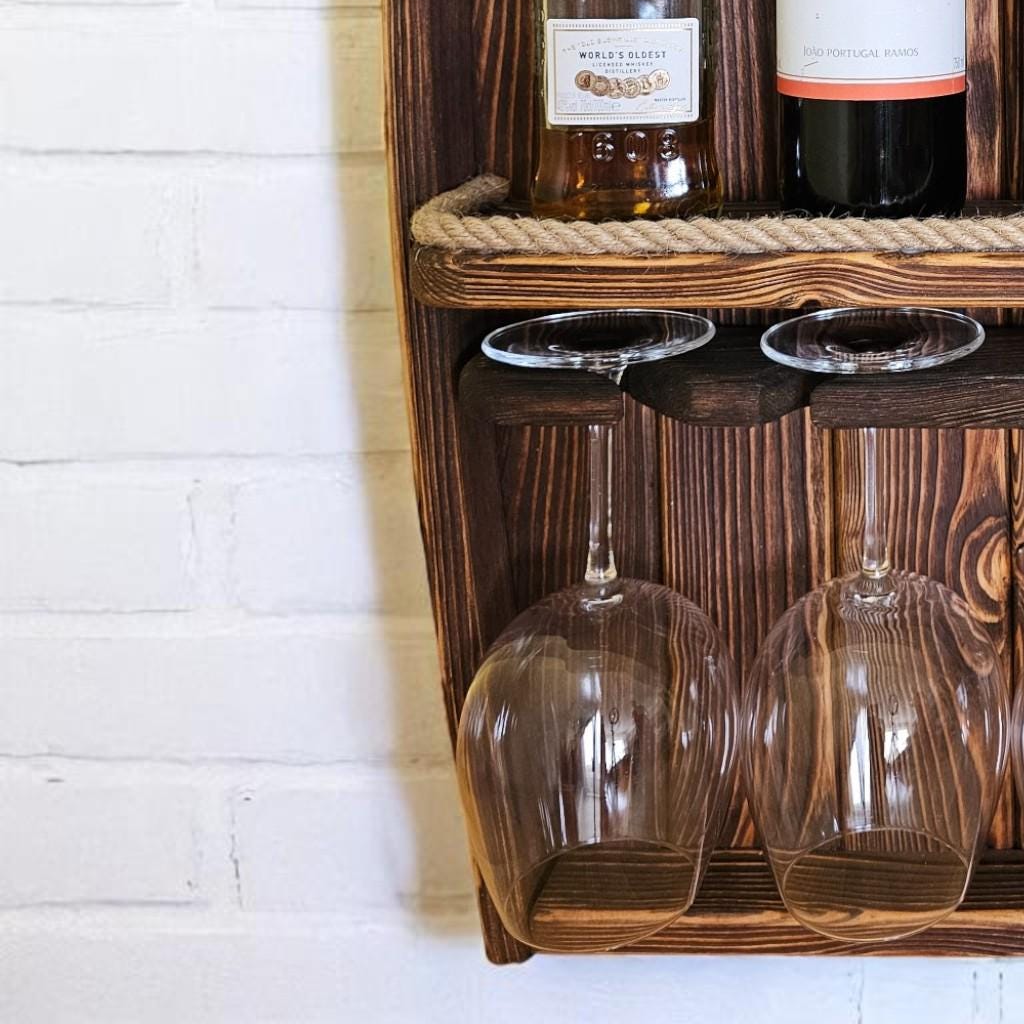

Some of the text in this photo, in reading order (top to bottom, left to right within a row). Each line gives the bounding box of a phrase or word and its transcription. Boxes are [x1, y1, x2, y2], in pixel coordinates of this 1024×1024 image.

[579, 50, 667, 60] WORLD'S OLDEST
[827, 48, 879, 58] PORTUGAL
[884, 47, 919, 57] RAMOS
